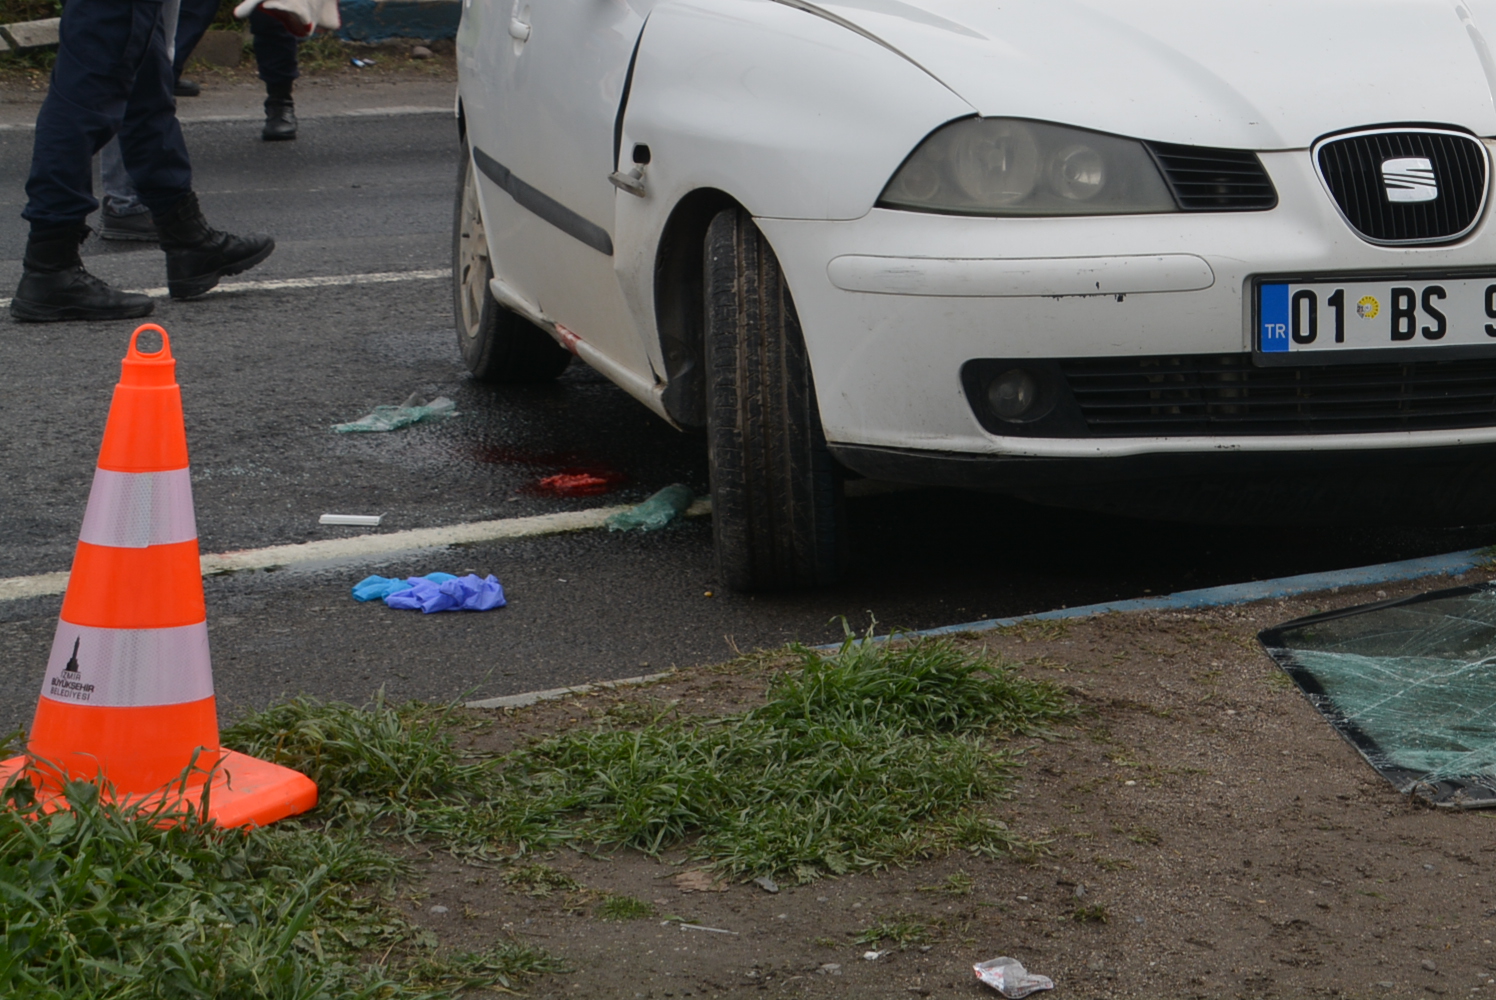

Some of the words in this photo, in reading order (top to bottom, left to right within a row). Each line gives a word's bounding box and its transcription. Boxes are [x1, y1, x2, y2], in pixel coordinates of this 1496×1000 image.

[1291, 288, 1345, 345] 01
[1390, 285, 1447, 342] BS
[1264, 323, 1286, 340] TR
[60, 669, 81, 681] İZMİR
[51, 676, 95, 693] BÜYÜKŞEHİR
[50, 686, 91, 701] BELEDİYESİ
